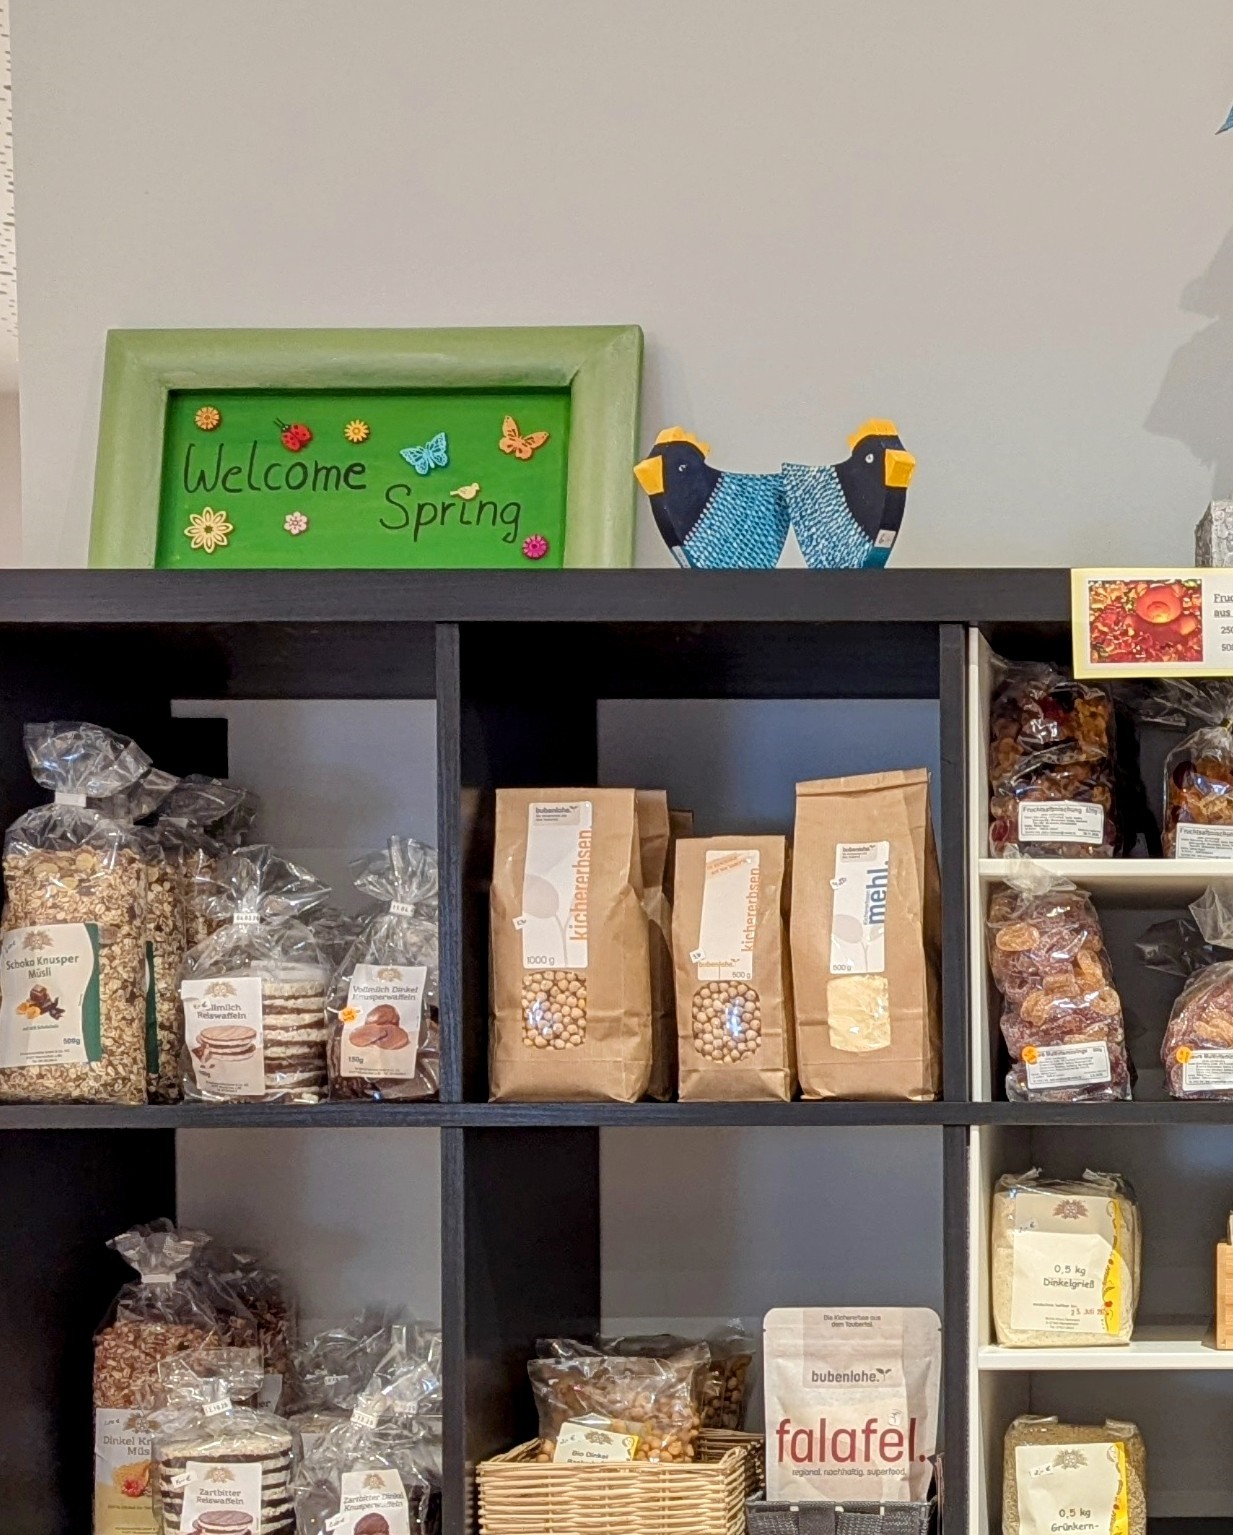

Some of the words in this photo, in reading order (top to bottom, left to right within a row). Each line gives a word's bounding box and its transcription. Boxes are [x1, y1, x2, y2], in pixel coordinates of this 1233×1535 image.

[183, 440, 367, 494] Welcome
[379, 484, 522, 543] Spring
[1214, 609, 1230, 617] aus
[570, 826, 592, 941] kichererbsen.
[866, 861, 888, 925] mehl.
[6, 960, 35, 970] Schoko
[37, 955, 79, 966] Knusper
[527, 956, 547, 964] 1000
[549, 957, 554, 965] g
[28, 967, 51, 979] Müsli
[197, 1012, 247, 1020] Reiswaffeln
[1054, 1265, 1071, 1275] 0,5
[1075, 1266, 1086, 1276] kg
[1043, 1278, 1094, 1289] Dinkelgrieß
[812, 1370, 879, 1383] bubenlohe.
[103, 1436, 135, 1446] Dinkel
[776, 1418, 926, 1463] falafel.
[199, 1488, 241, 1498] Zartbitter
[1059, 1509, 1075, 1519] 0,5
[1080, 1508, 1091, 1518] kg
[1051, 1522, 1099, 1532] Grünkern-
